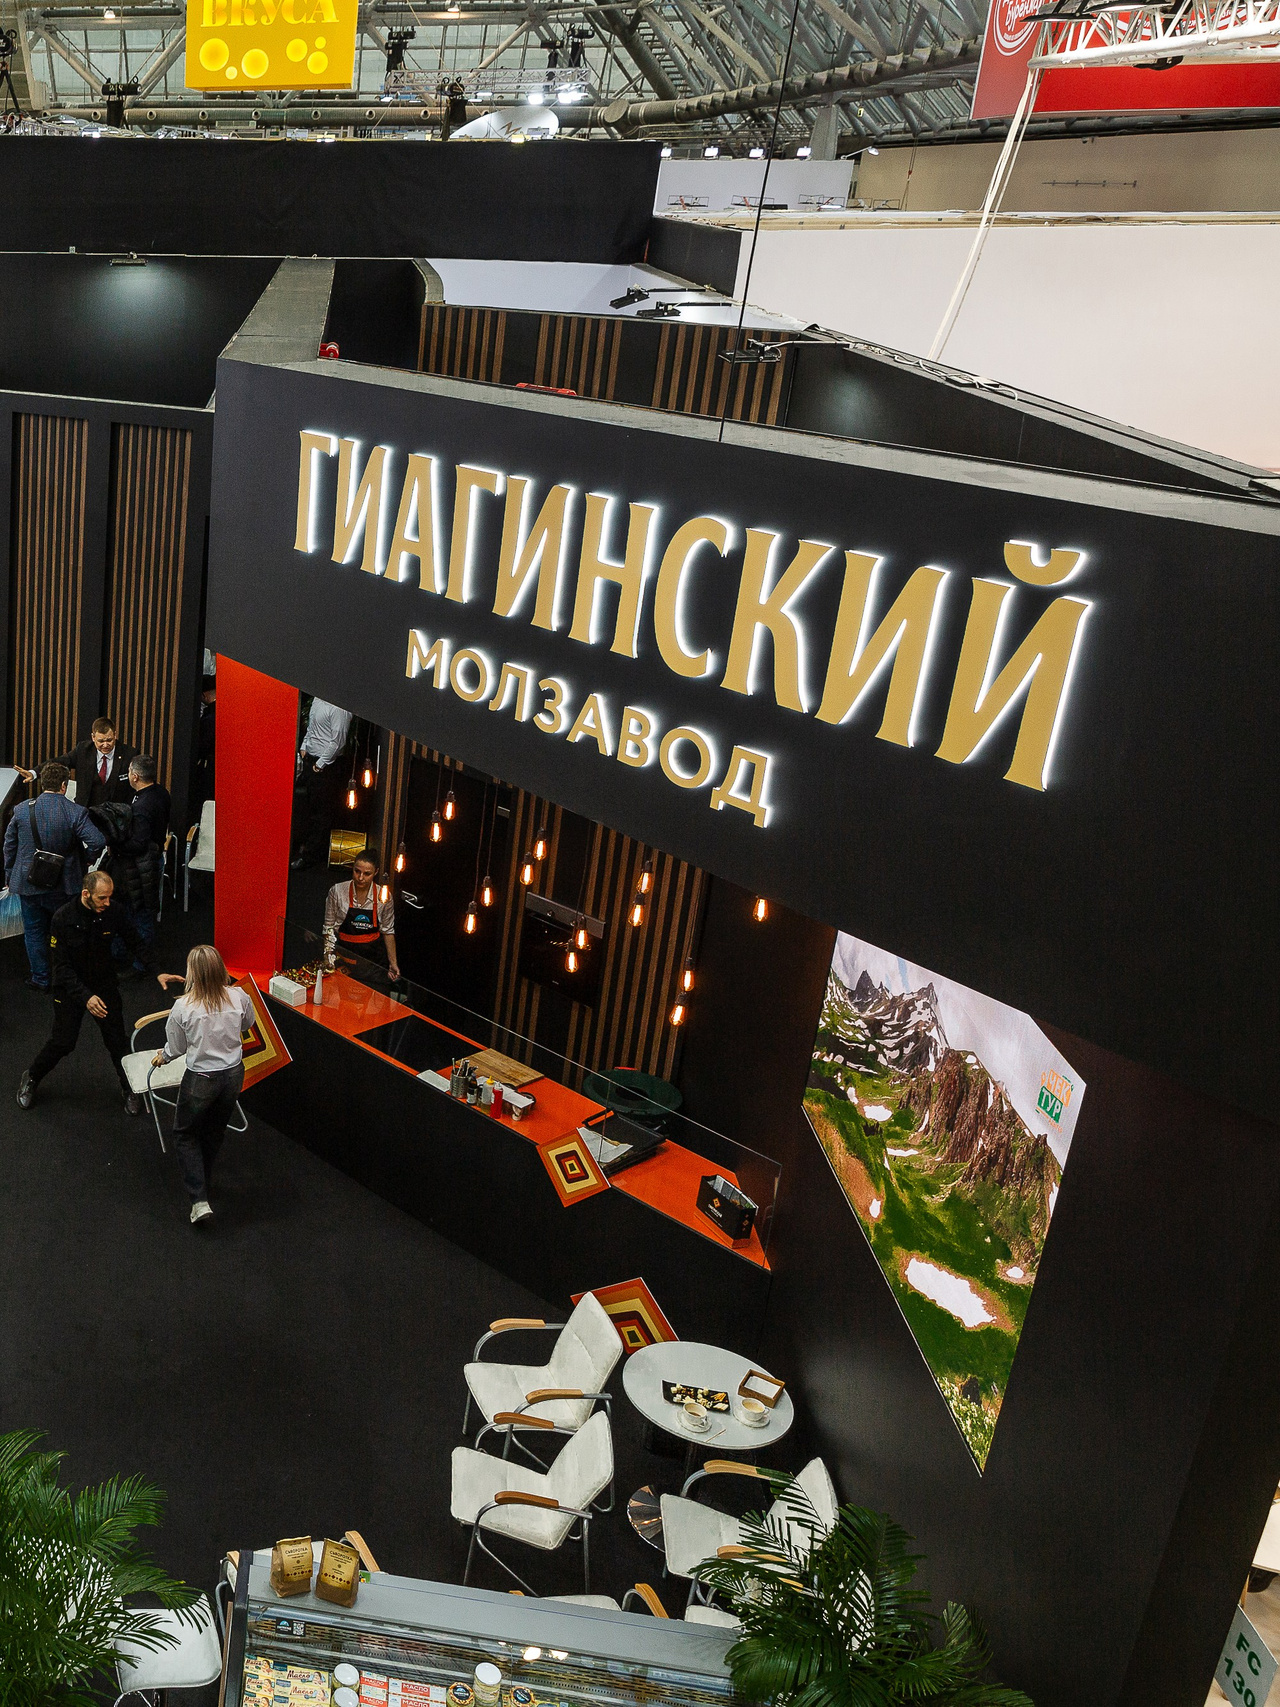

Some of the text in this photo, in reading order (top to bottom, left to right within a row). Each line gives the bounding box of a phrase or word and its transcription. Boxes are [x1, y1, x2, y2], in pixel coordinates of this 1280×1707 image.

[294, 430, 1094, 792] ГИАГИНСКИЙ
[404, 628, 774, 828] МОЛЗАВОД
[1040, 1087, 1061, 1118] ТУР
[1047, 1070, 1071, 1107] ЧЕК
[402, 1682, 429, 1693] МАСЛО
